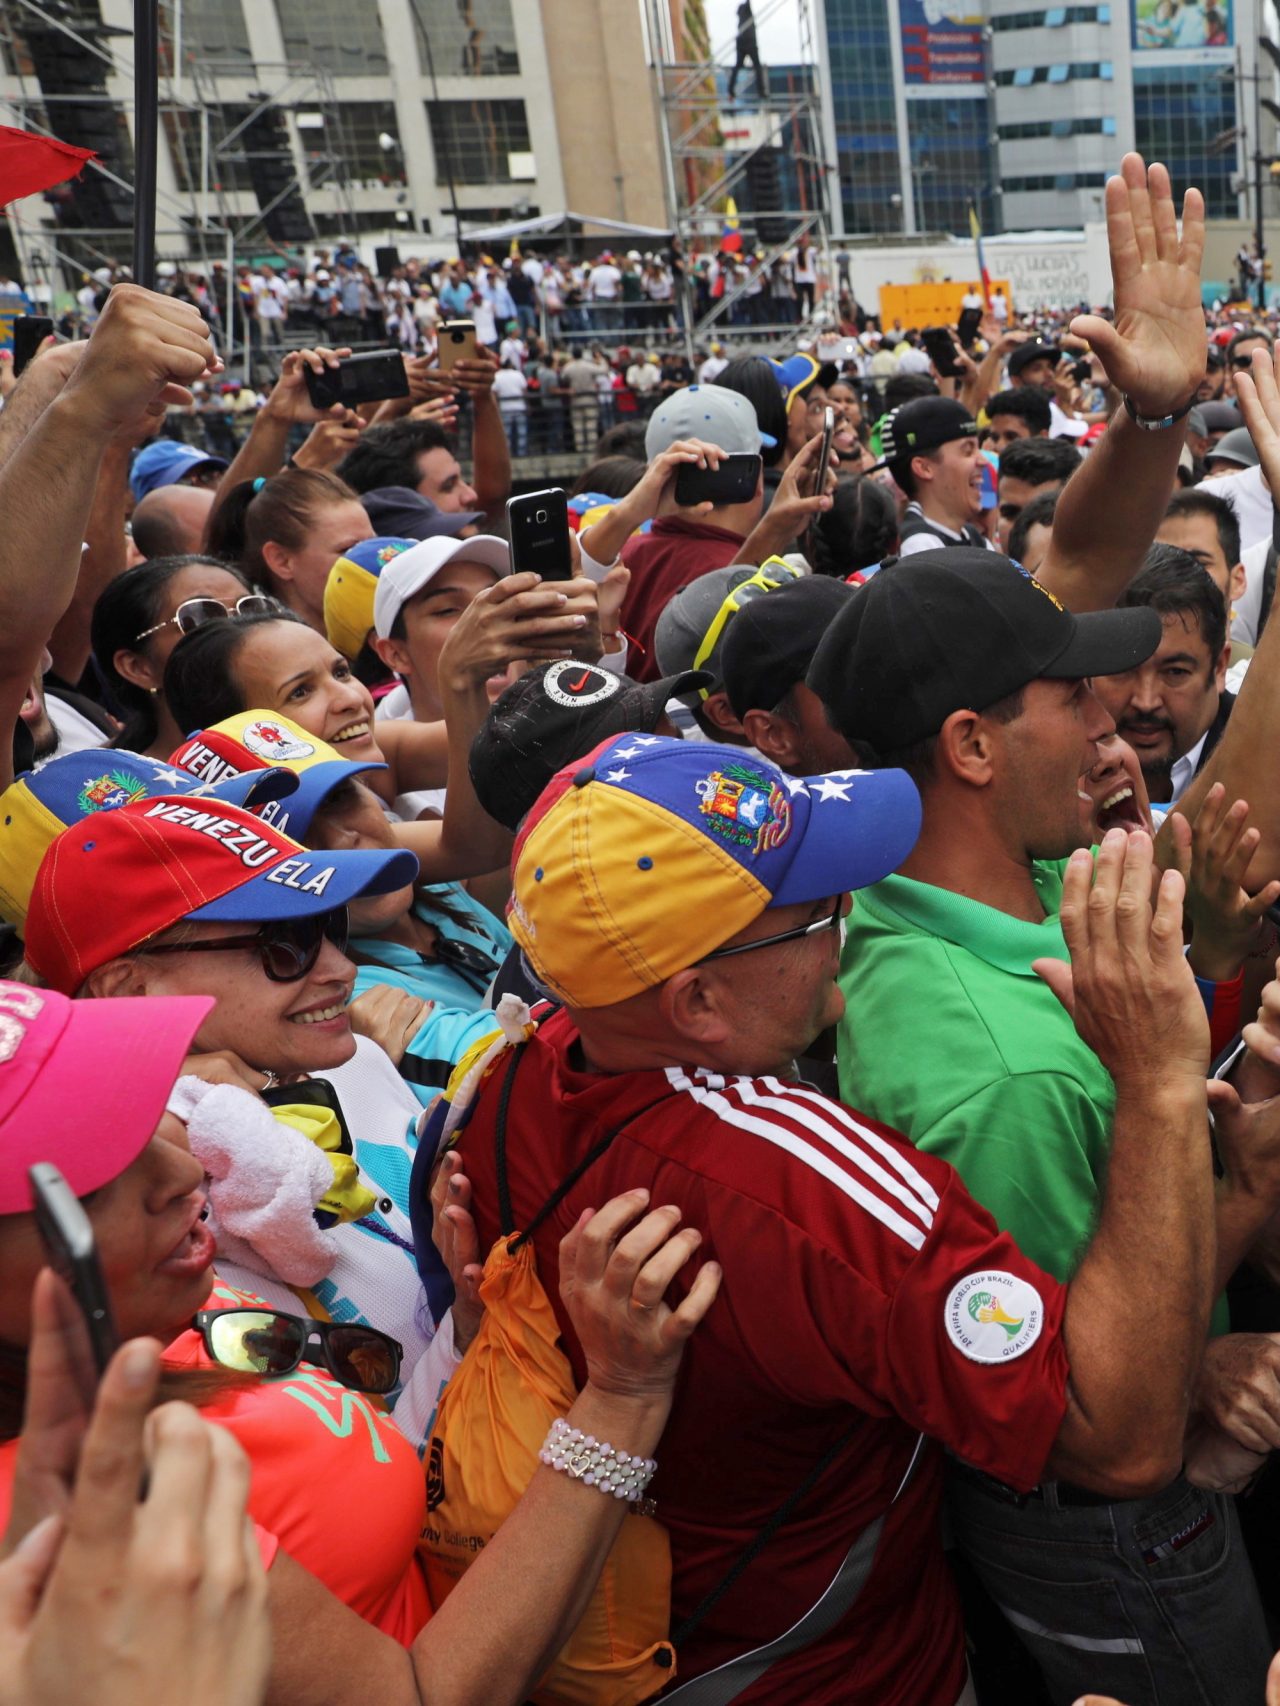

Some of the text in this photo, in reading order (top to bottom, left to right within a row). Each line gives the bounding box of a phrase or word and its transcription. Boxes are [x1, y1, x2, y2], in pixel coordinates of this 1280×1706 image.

[970, 1276, 986, 1286] CUP
[987, 1276, 1014, 1287] BRAZIL
[953, 1284, 971, 1309] WORLD
[952, 1311, 960, 1329] FIFA
[1002, 1310, 1037, 1356] QUALIFIERS
